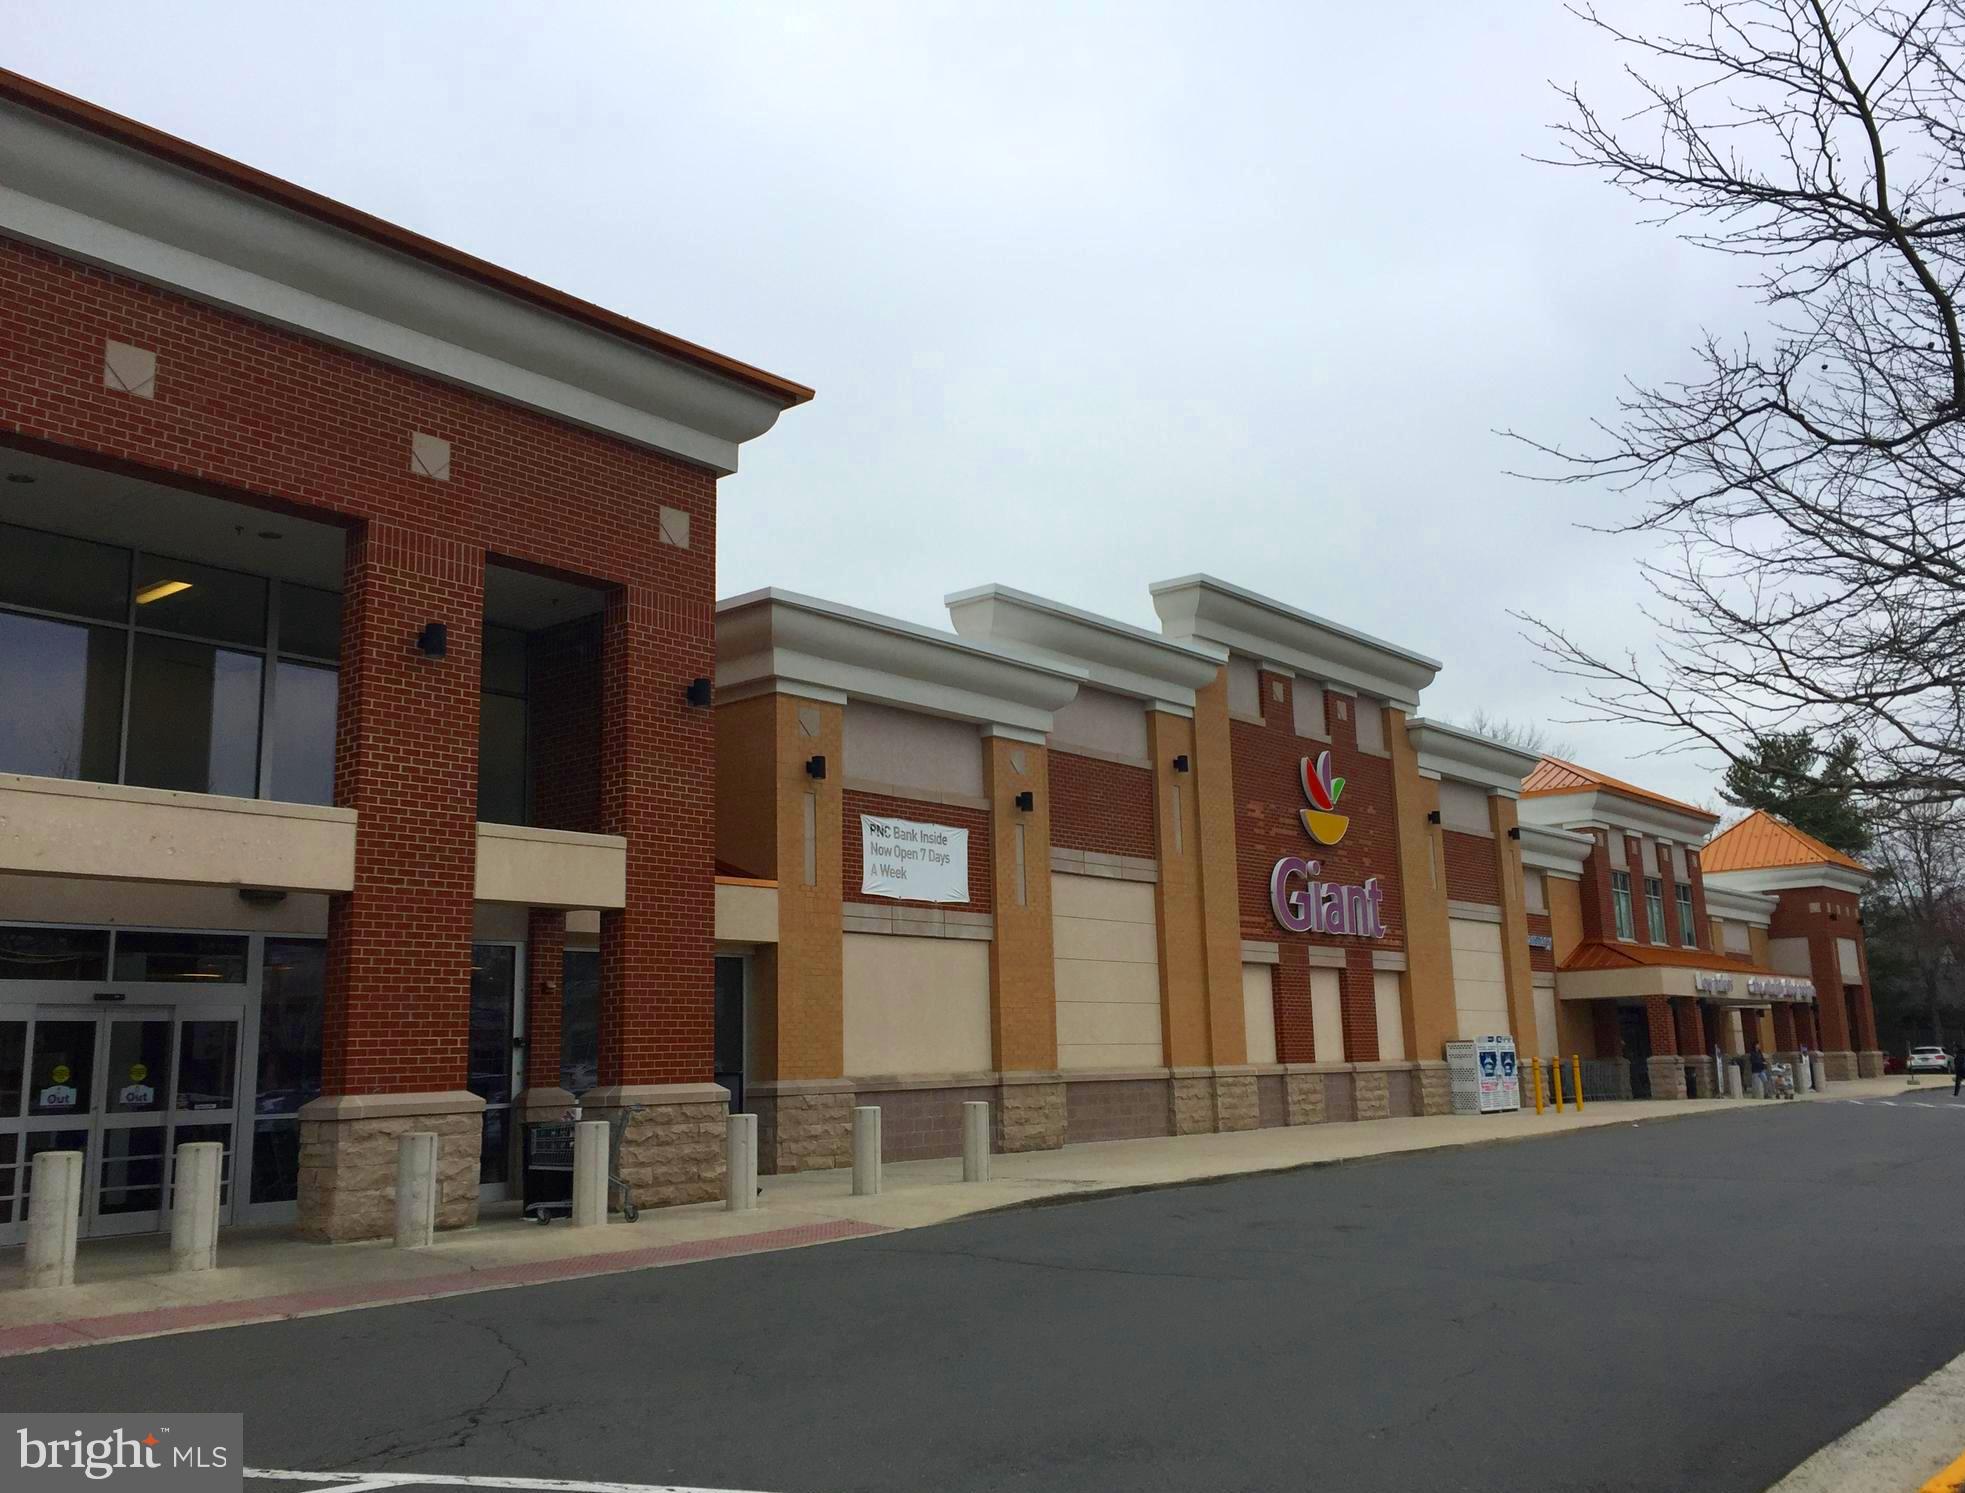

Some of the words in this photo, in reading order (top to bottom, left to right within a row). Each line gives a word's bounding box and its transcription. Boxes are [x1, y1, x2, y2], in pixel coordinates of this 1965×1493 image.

[869, 823, 891, 839] PNC
[893, 826, 918, 843] Bank
[920, 829, 948, 846] Inside
[870, 841, 893, 857] Now
[894, 845, 918, 862] Open
[920, 848, 926, 861] 7
[928, 849, 951, 865] Days
[871, 864, 878, 876] A
[879, 864, 908, 880] Week
[1270, 856, 1387, 939] Giant
[48, 1094, 69, 1104] Out
[126, 1092, 147, 1102] Out
